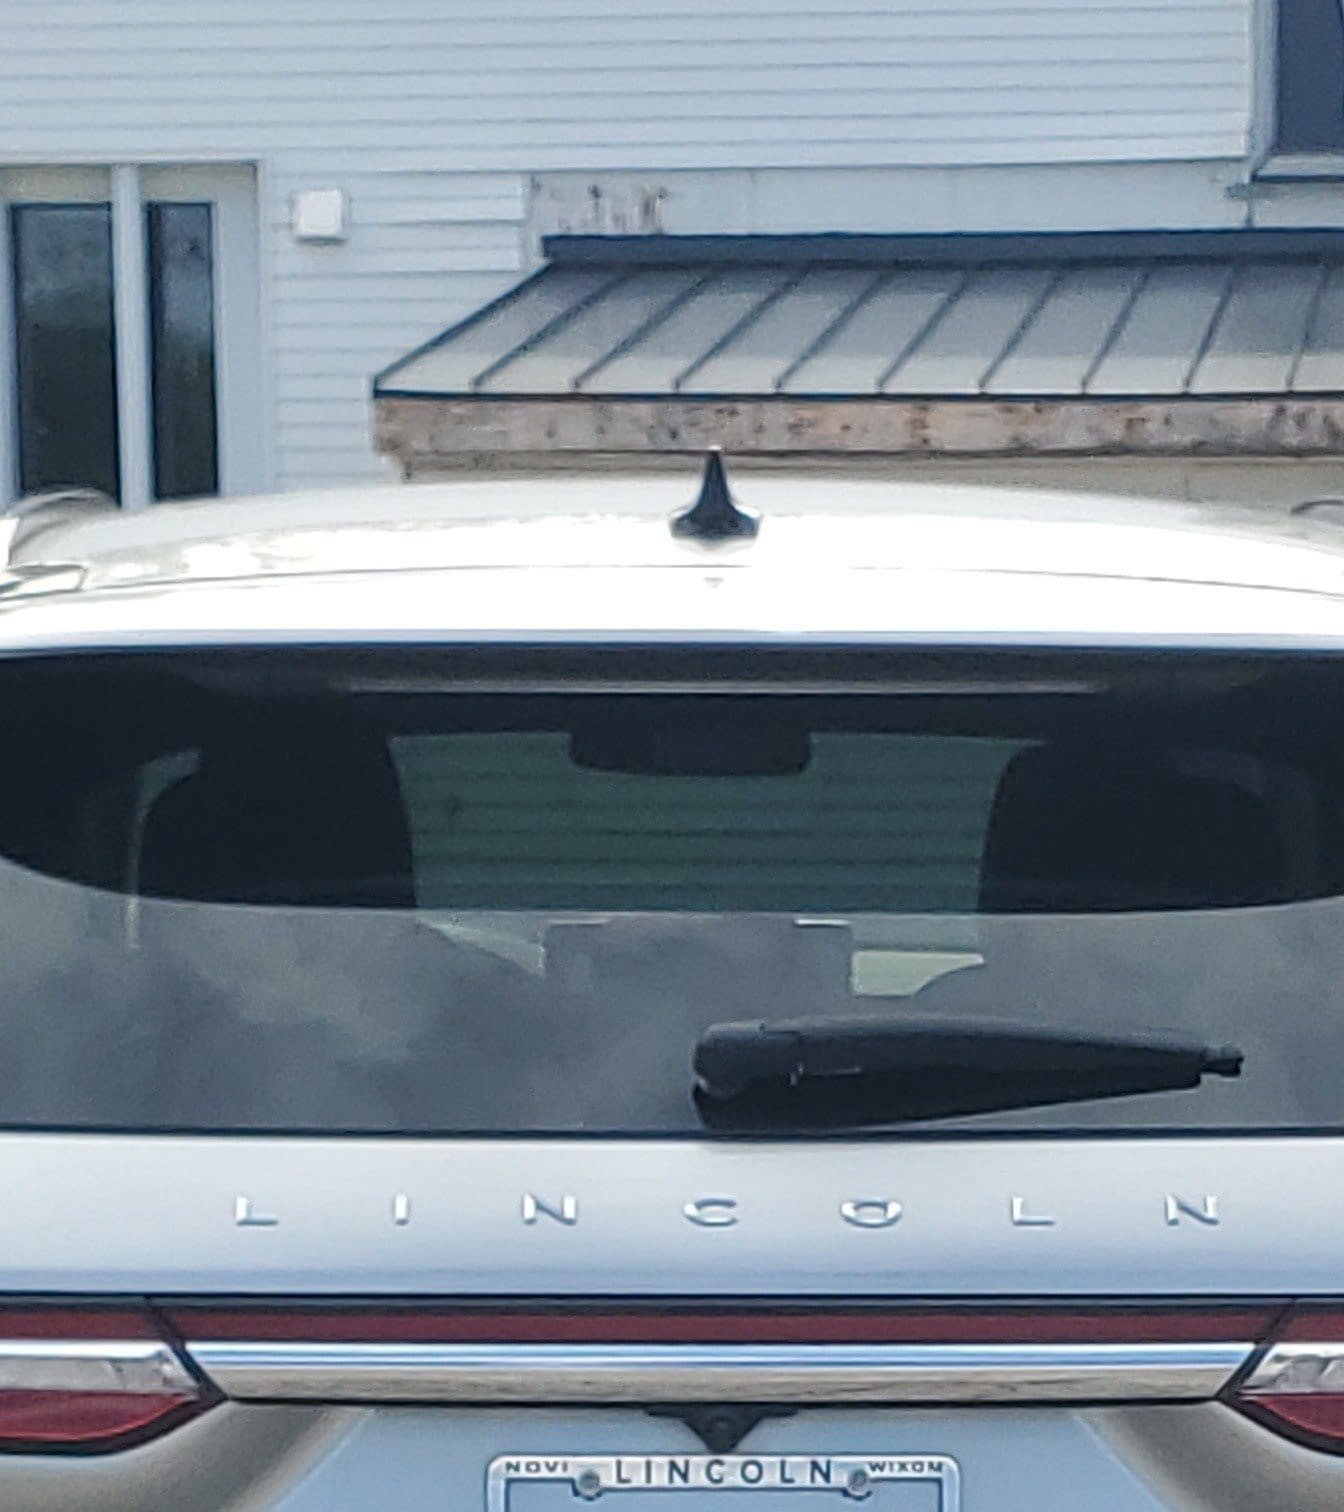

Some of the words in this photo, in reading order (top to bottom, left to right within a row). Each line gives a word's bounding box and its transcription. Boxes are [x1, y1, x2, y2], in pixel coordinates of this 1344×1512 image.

[235, 1194, 1220, 1228] LINCOLN
[506, 1460, 568, 1473] NOVI
[615, 1459, 832, 1484] LINCOLN
[868, 1460, 943, 1473] WIXOM
